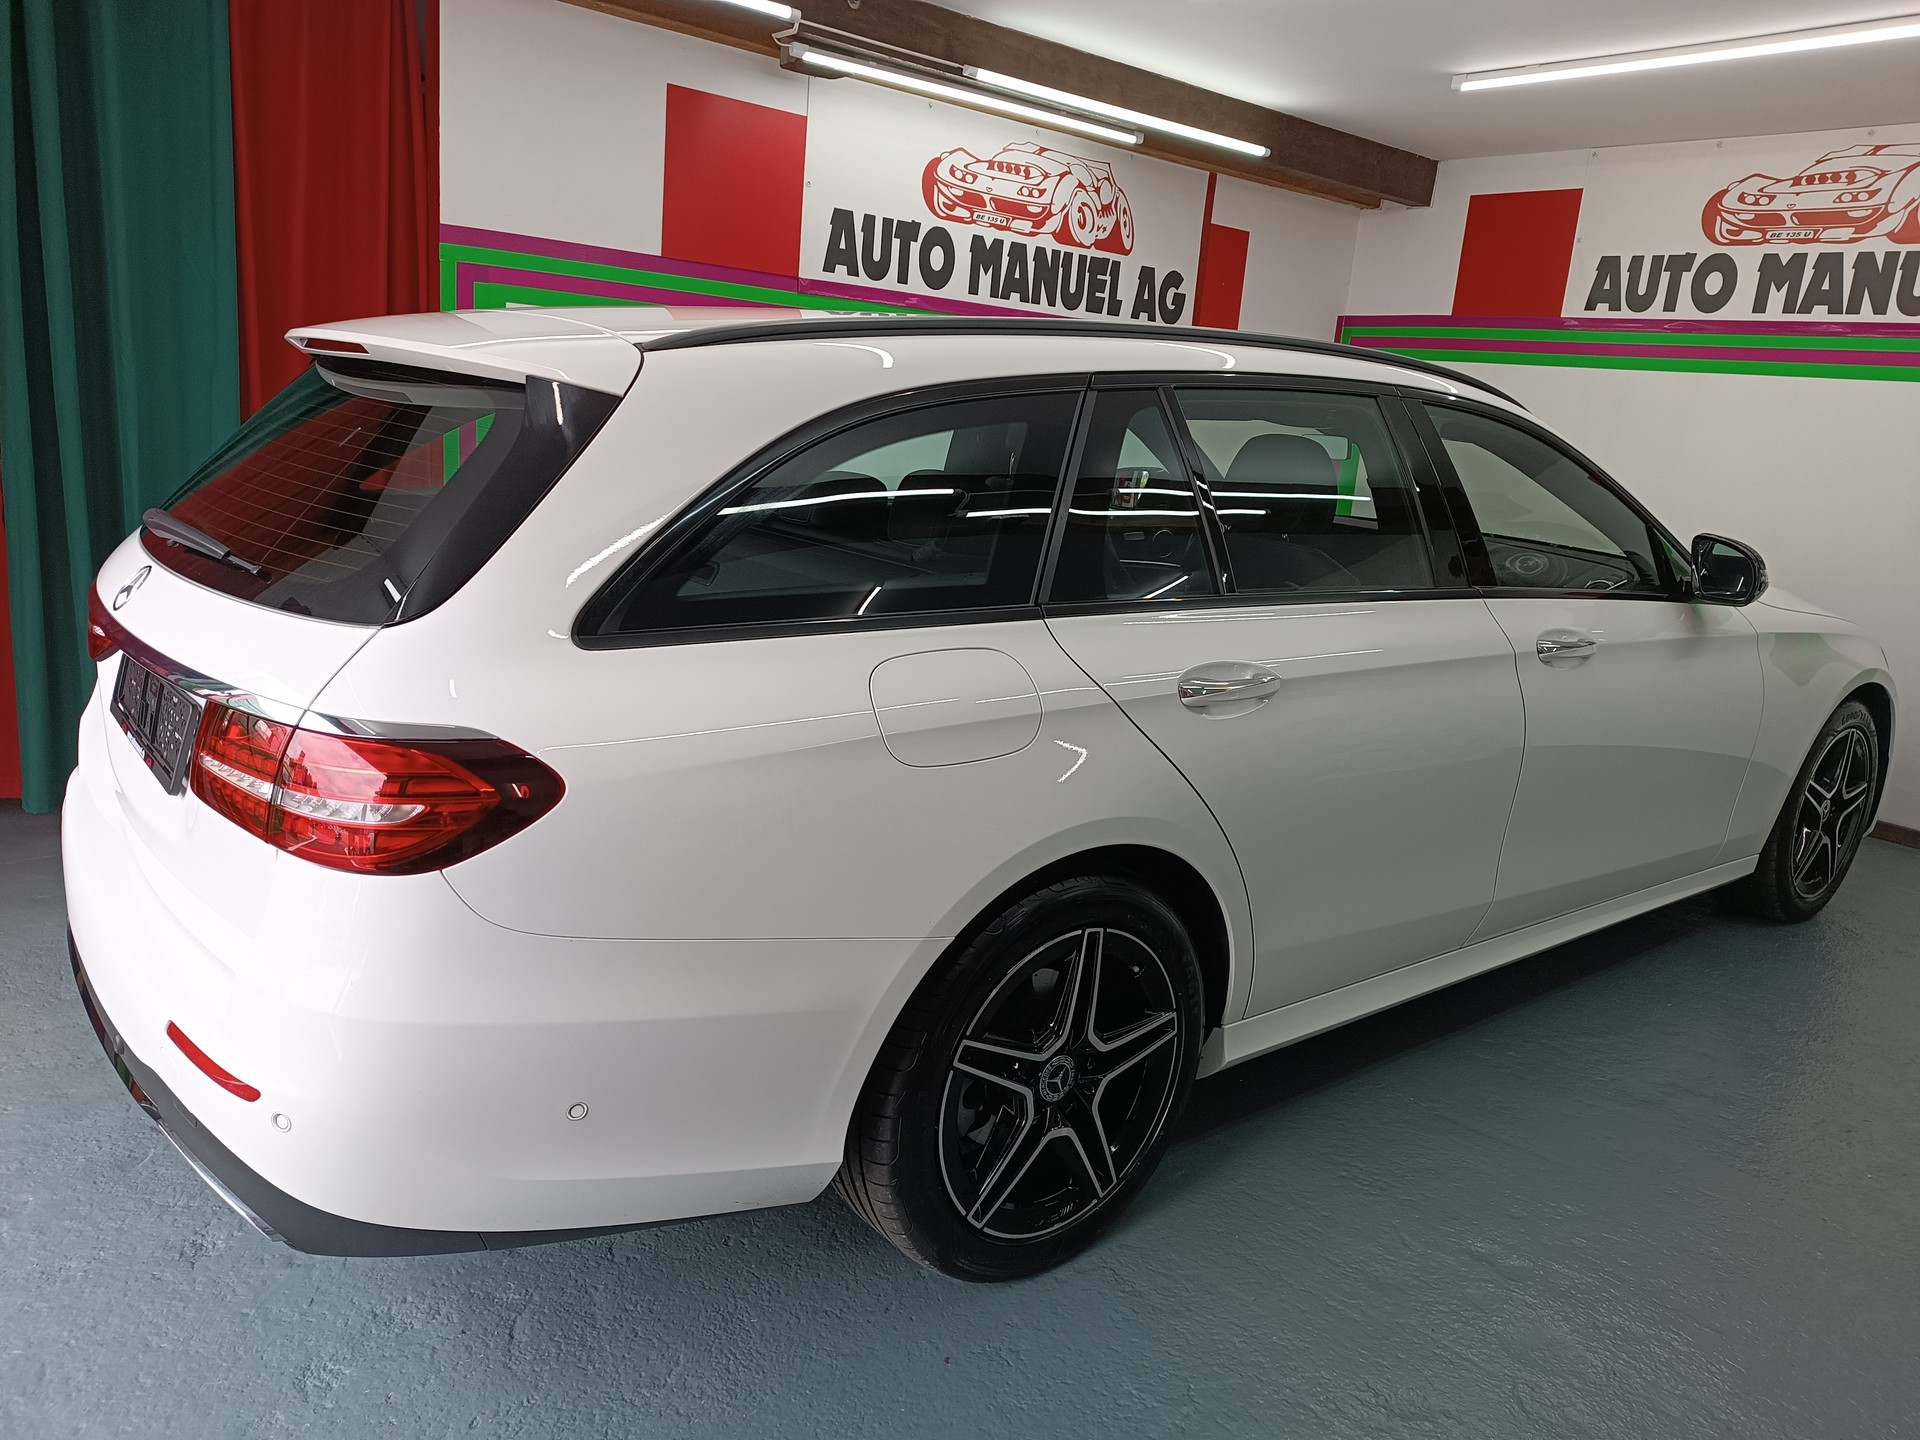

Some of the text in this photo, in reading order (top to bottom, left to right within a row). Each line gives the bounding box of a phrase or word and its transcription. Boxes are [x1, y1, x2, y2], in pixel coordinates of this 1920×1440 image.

[975, 213, 986, 221] BE
[822, 207, 1187, 326] AUTO MANUEL AG
[1583, 251, 1738, 314] AUTO
